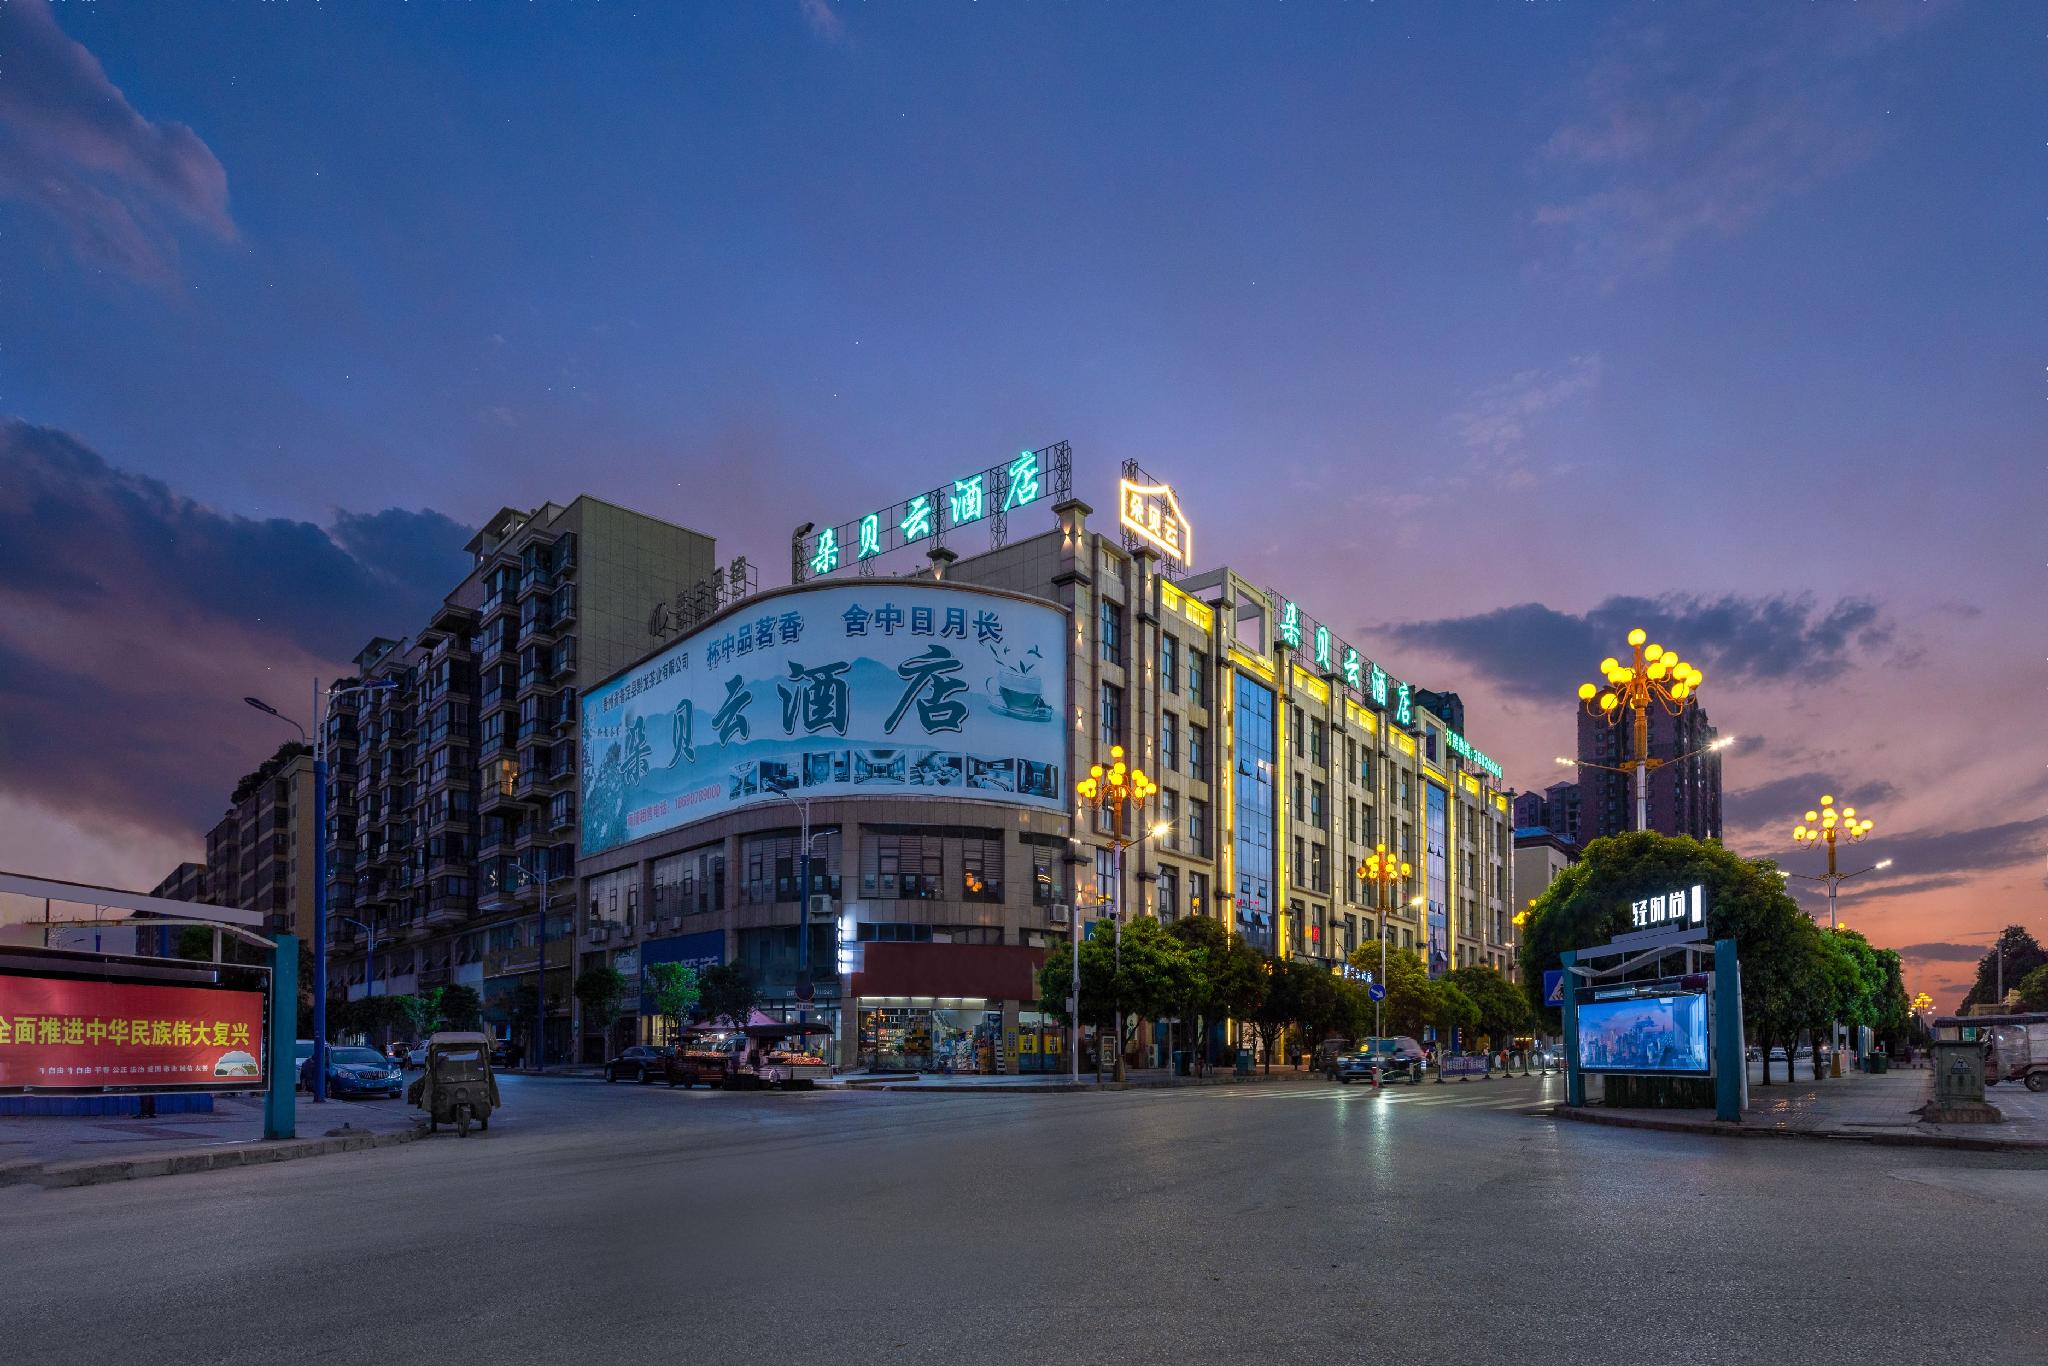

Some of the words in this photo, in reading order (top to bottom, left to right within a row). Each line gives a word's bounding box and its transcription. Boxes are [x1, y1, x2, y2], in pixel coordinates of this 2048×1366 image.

[810, 450, 1039, 574] 朵贝云酒店
[1129, 492, 1179, 549] 朵贝云
[706, 609, 804, 668] 杯中品茗香
[841, 602, 1002, 645] 舍中日月长
[1279, 601, 1412, 726] 朵贝云酒店
[620, 644, 970, 787] 朵贝云酒店
[1631, 890, 1686, 927] 轻时尚
